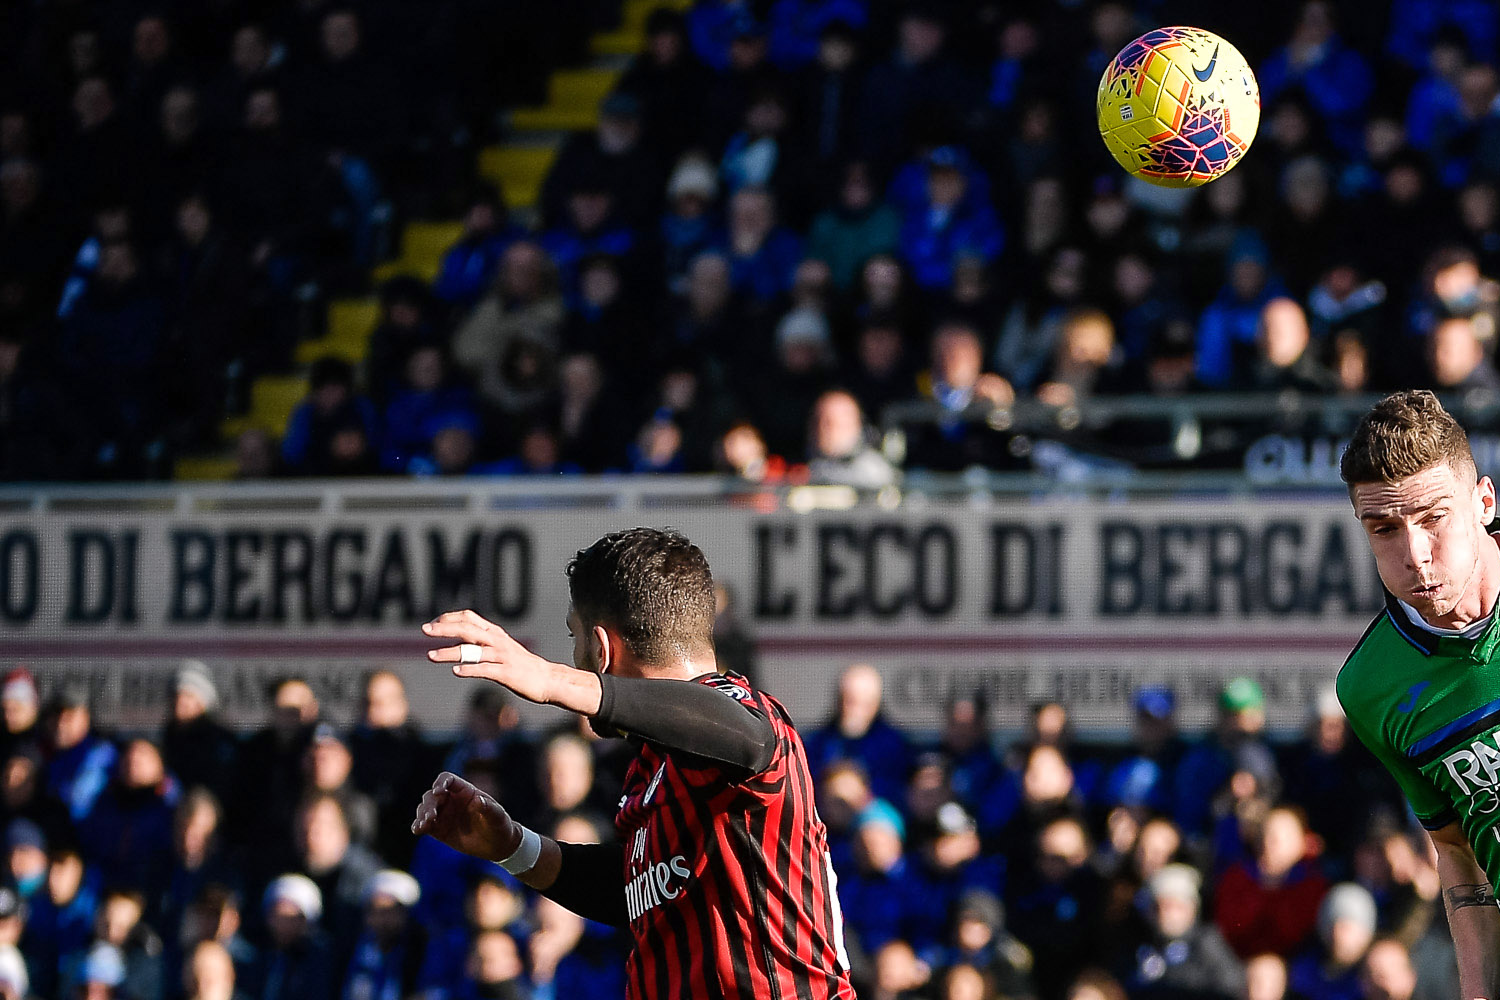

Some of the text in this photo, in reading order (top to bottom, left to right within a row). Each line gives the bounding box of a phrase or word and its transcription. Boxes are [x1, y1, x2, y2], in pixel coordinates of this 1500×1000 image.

[66, 528, 139, 624] DI
[170, 524, 534, 624] BERGAMO
[753, 516, 1382, 620] L'ECO DI BERGA
[624, 855, 691, 922] mirates
